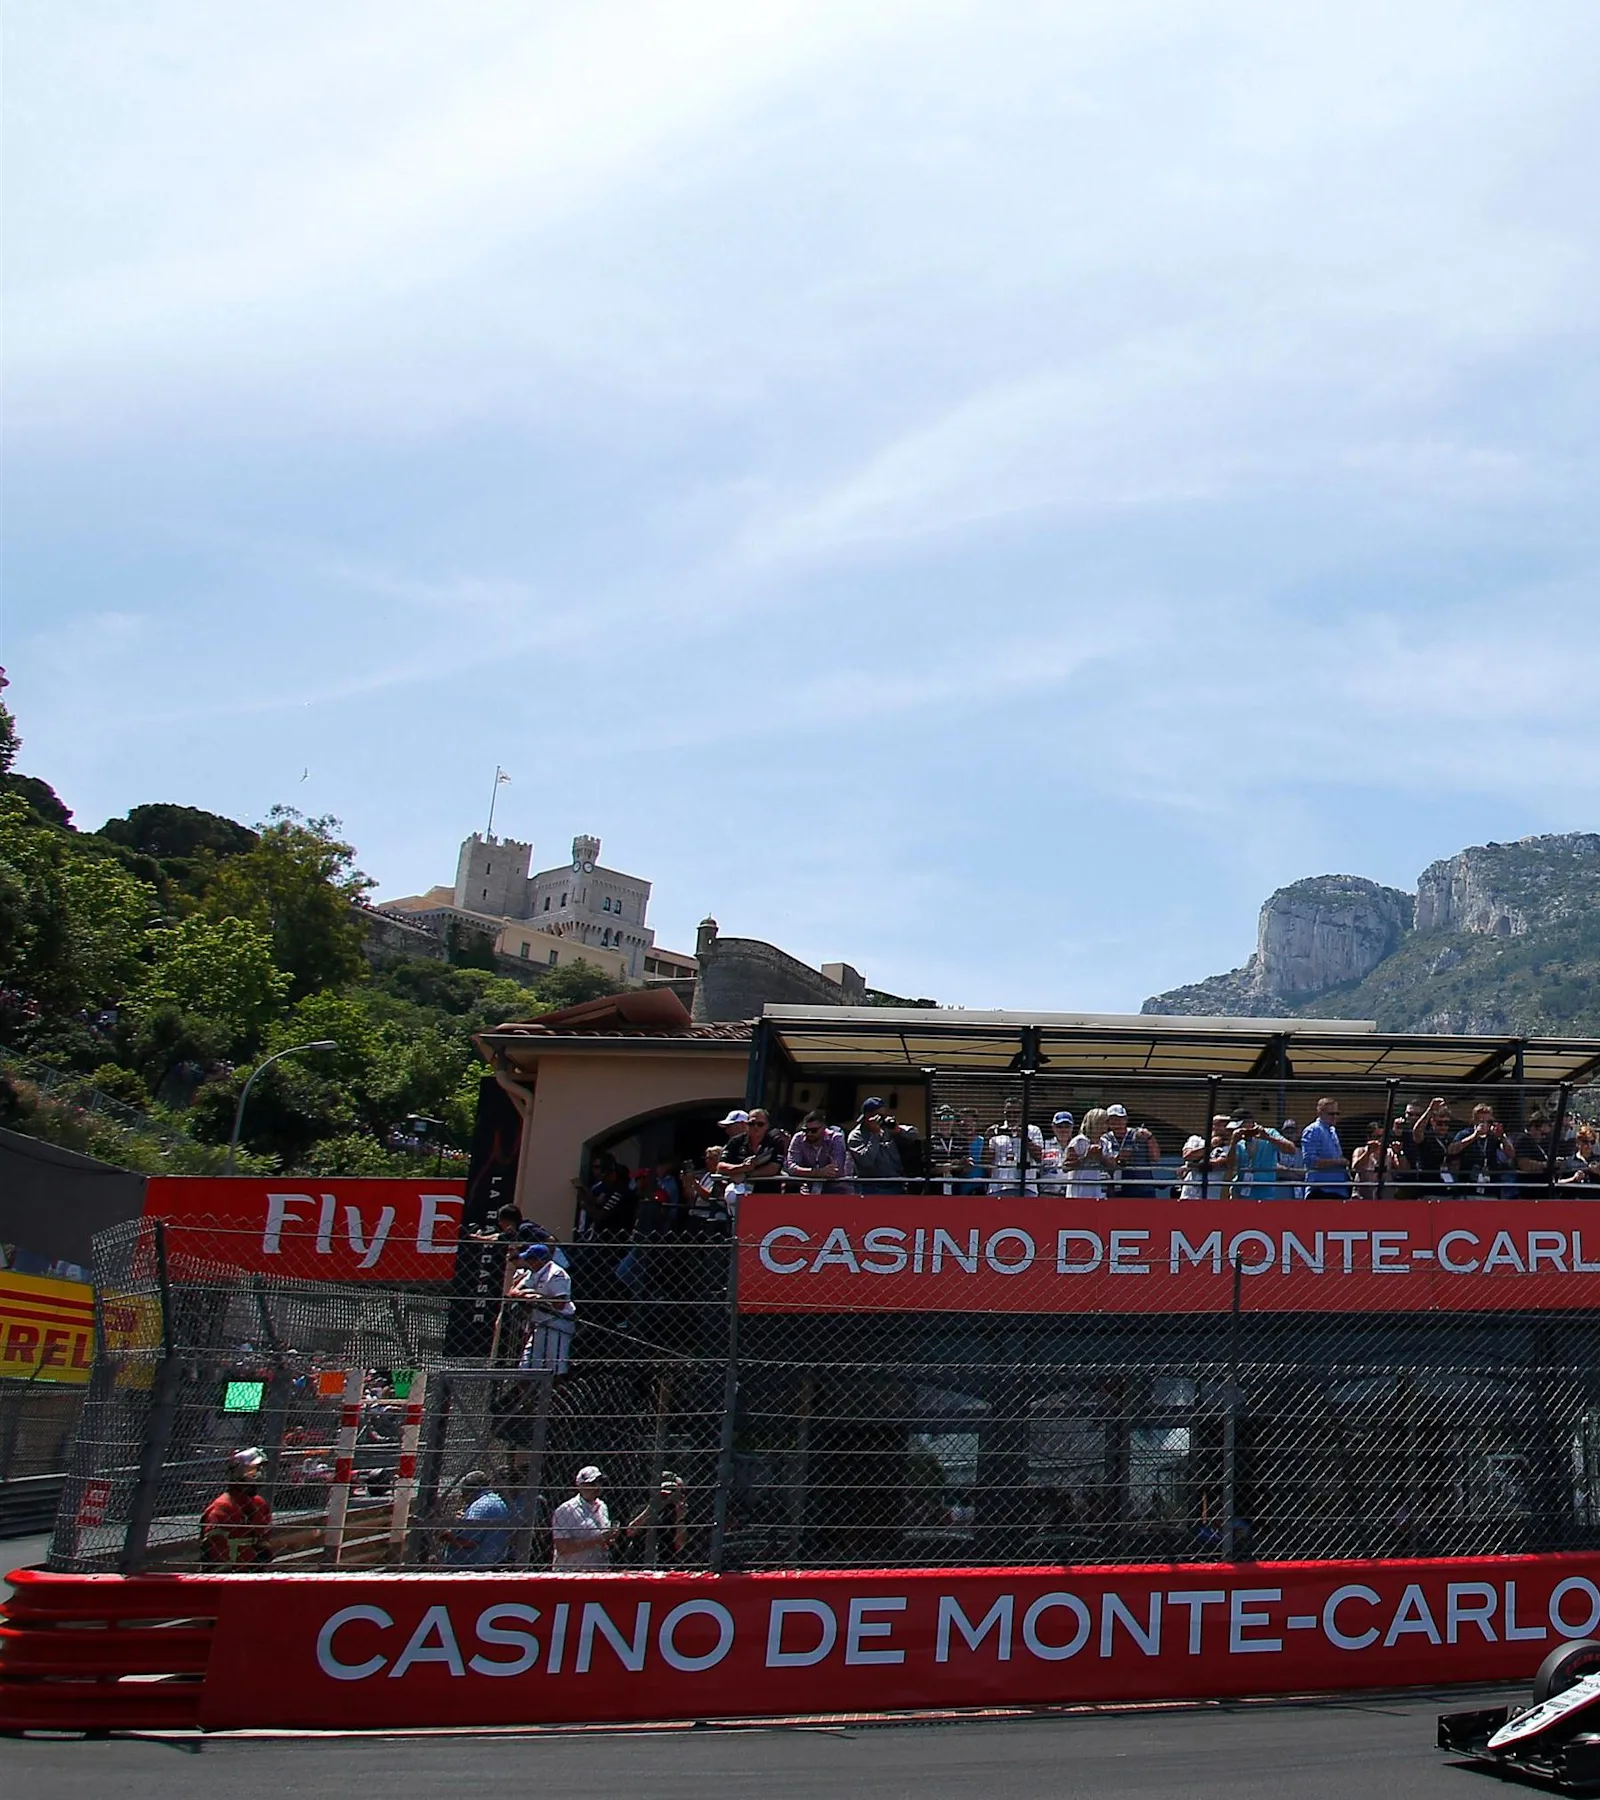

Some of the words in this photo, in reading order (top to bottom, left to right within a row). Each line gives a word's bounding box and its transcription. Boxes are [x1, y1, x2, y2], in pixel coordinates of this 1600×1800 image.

[489, 1176, 502, 1199] LA
[262, 1193, 395, 1268] Fly
[758, 1225, 1037, 1276] CASINO
[1056, 1228, 1151, 1276] DE
[0, 1323, 93, 1369] REL
[317, 1598, 736, 1681] CASINO
[766, 1597, 908, 1668] DE
